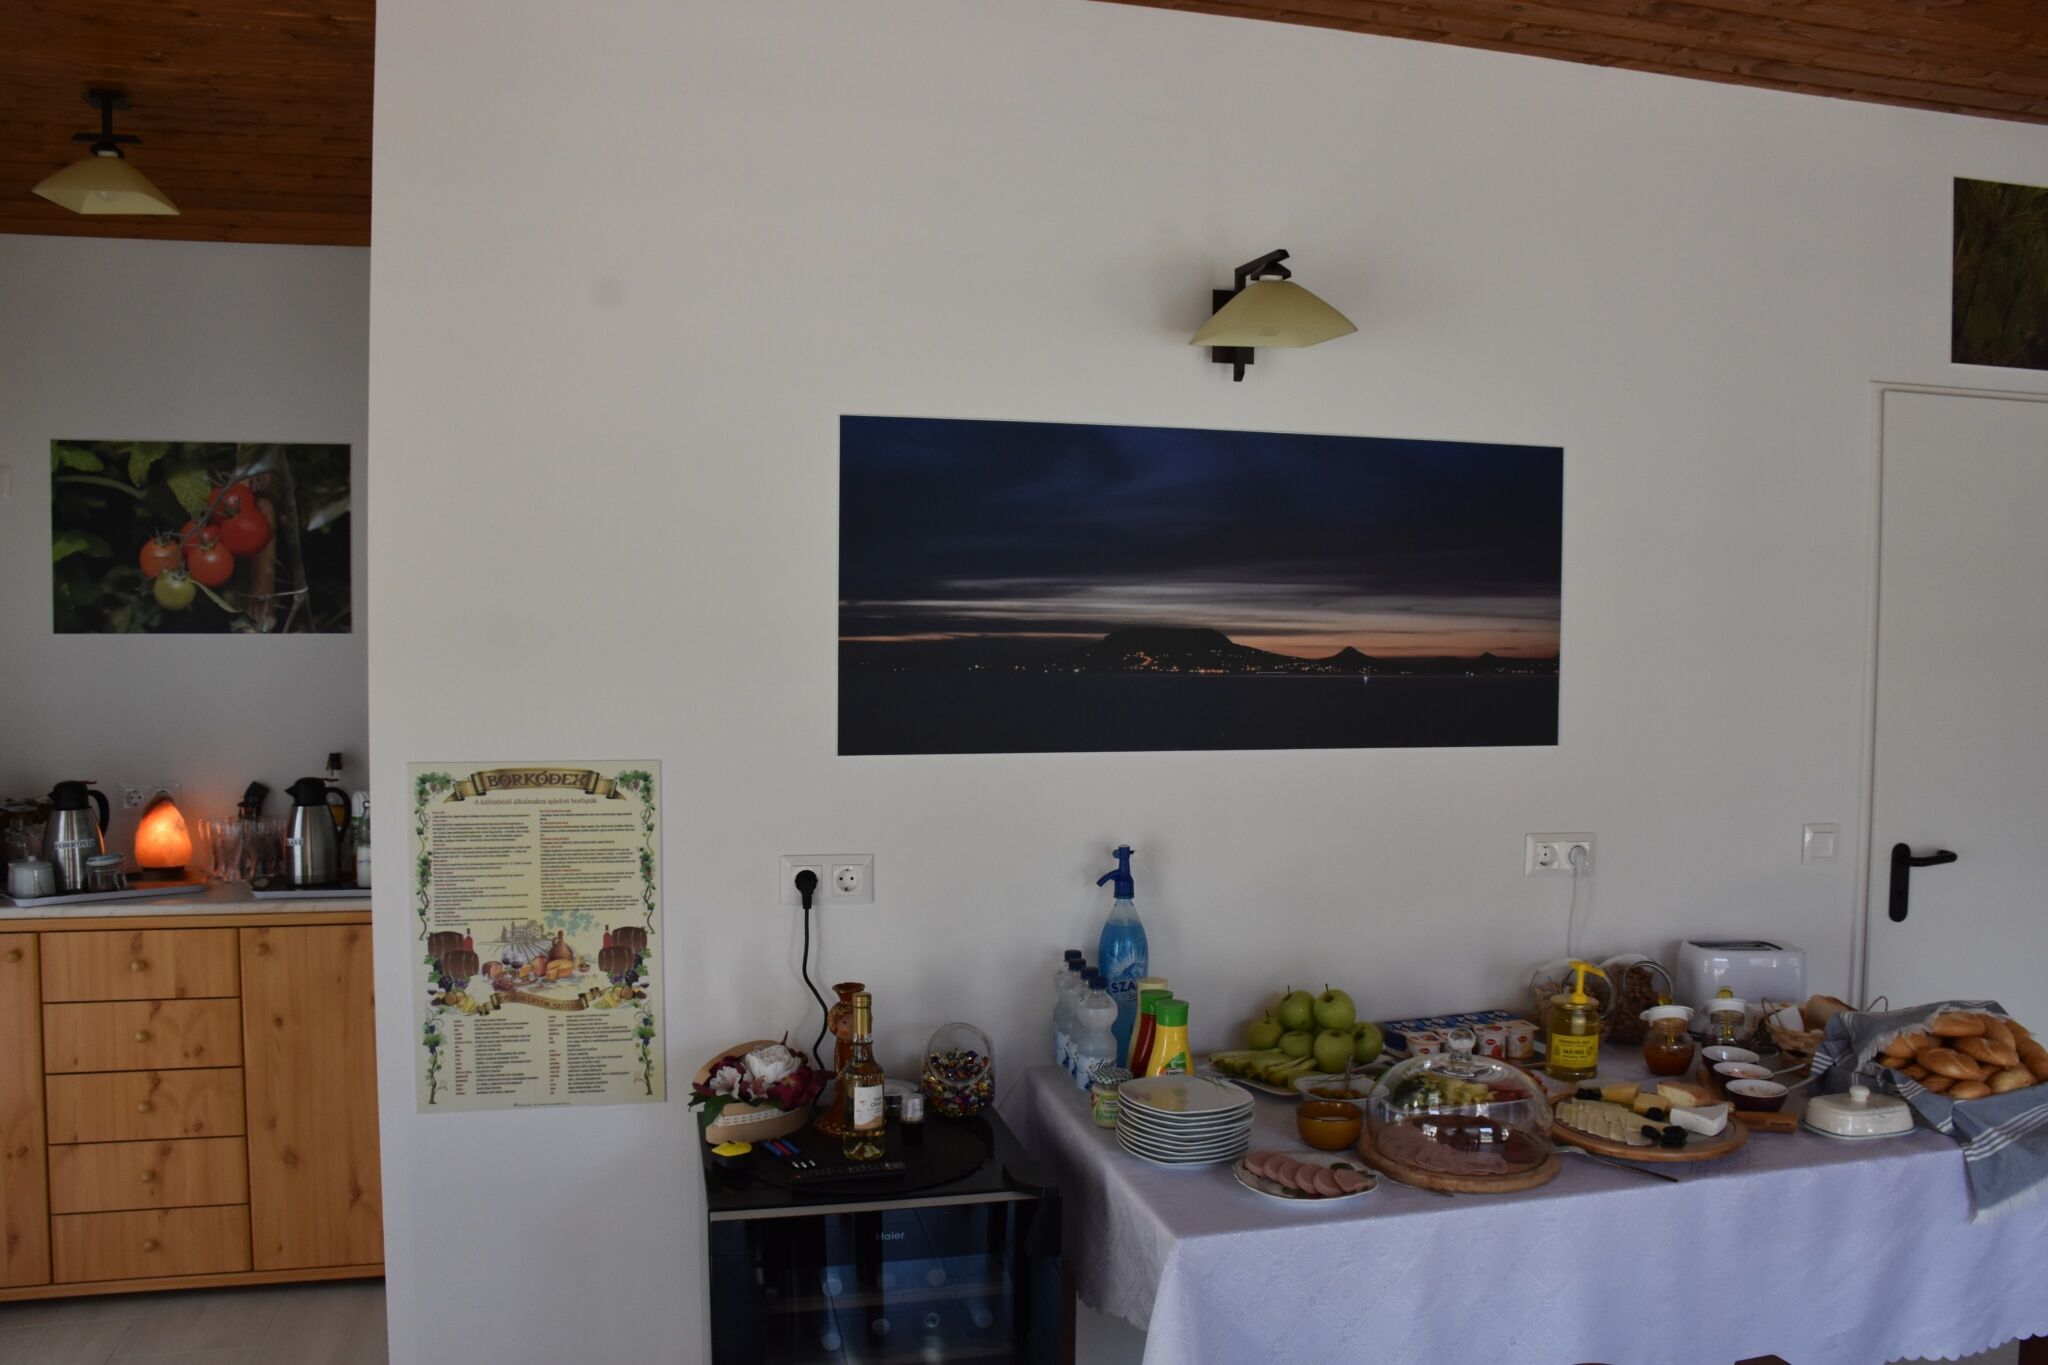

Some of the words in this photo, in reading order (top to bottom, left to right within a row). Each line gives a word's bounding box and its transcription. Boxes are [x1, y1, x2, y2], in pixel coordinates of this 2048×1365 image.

[487, 771, 588, 788] BORKÓDEX
[1111, 980, 1137, 993] SZA
[875, 1231, 905, 1240] Haier
